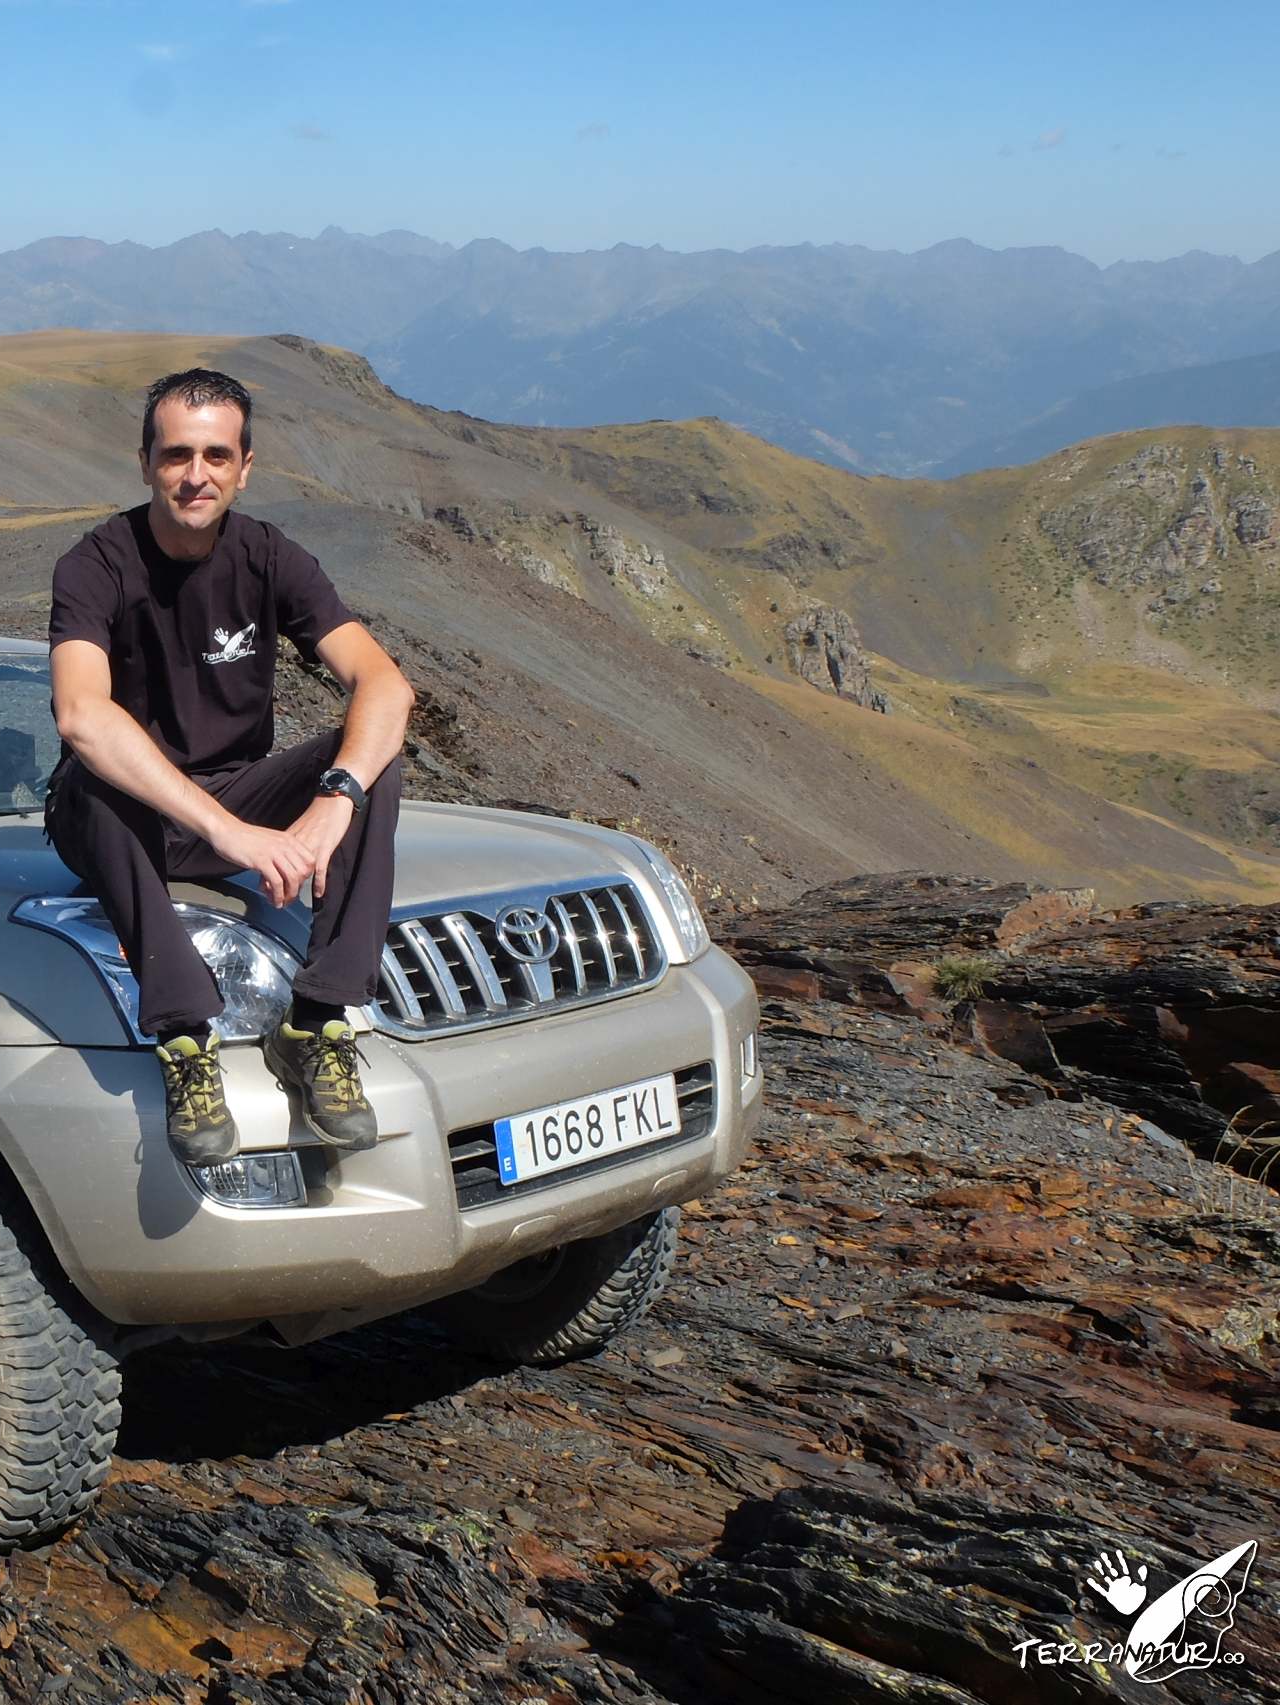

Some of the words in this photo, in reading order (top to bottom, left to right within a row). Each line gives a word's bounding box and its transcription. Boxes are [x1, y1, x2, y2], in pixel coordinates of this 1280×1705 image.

[525, 1104, 604, 1167] 1668
[612, 1087, 673, 1142] FKL
[503, 1157, 513, 1172] E
